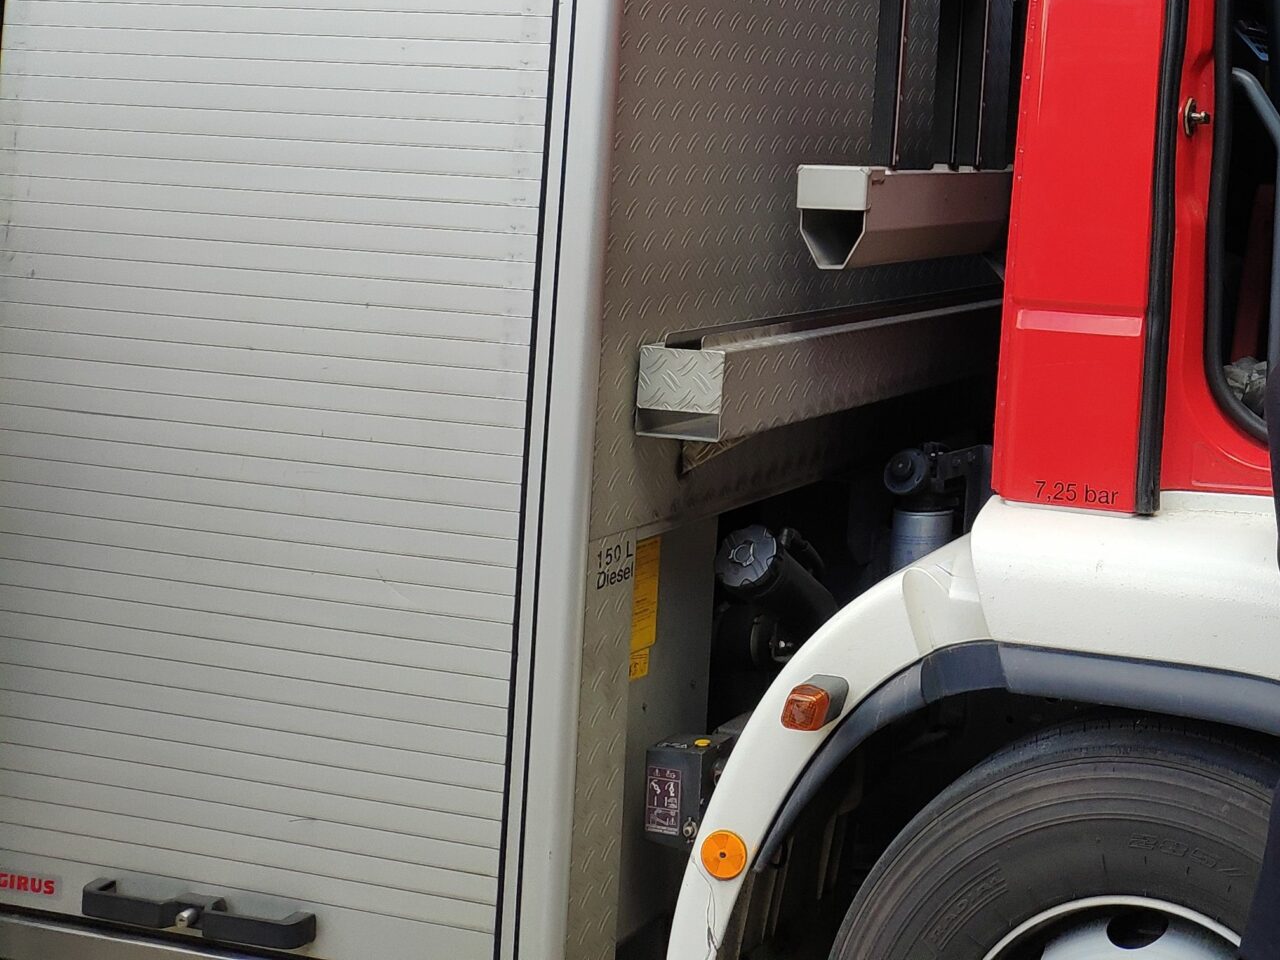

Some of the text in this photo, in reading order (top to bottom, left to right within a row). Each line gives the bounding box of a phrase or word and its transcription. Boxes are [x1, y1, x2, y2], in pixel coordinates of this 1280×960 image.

[1035, 480, 1118, 504] 7,25 bar
[598, 540, 634, 568] 150 L
[596, 561, 634, 590] Diesel
